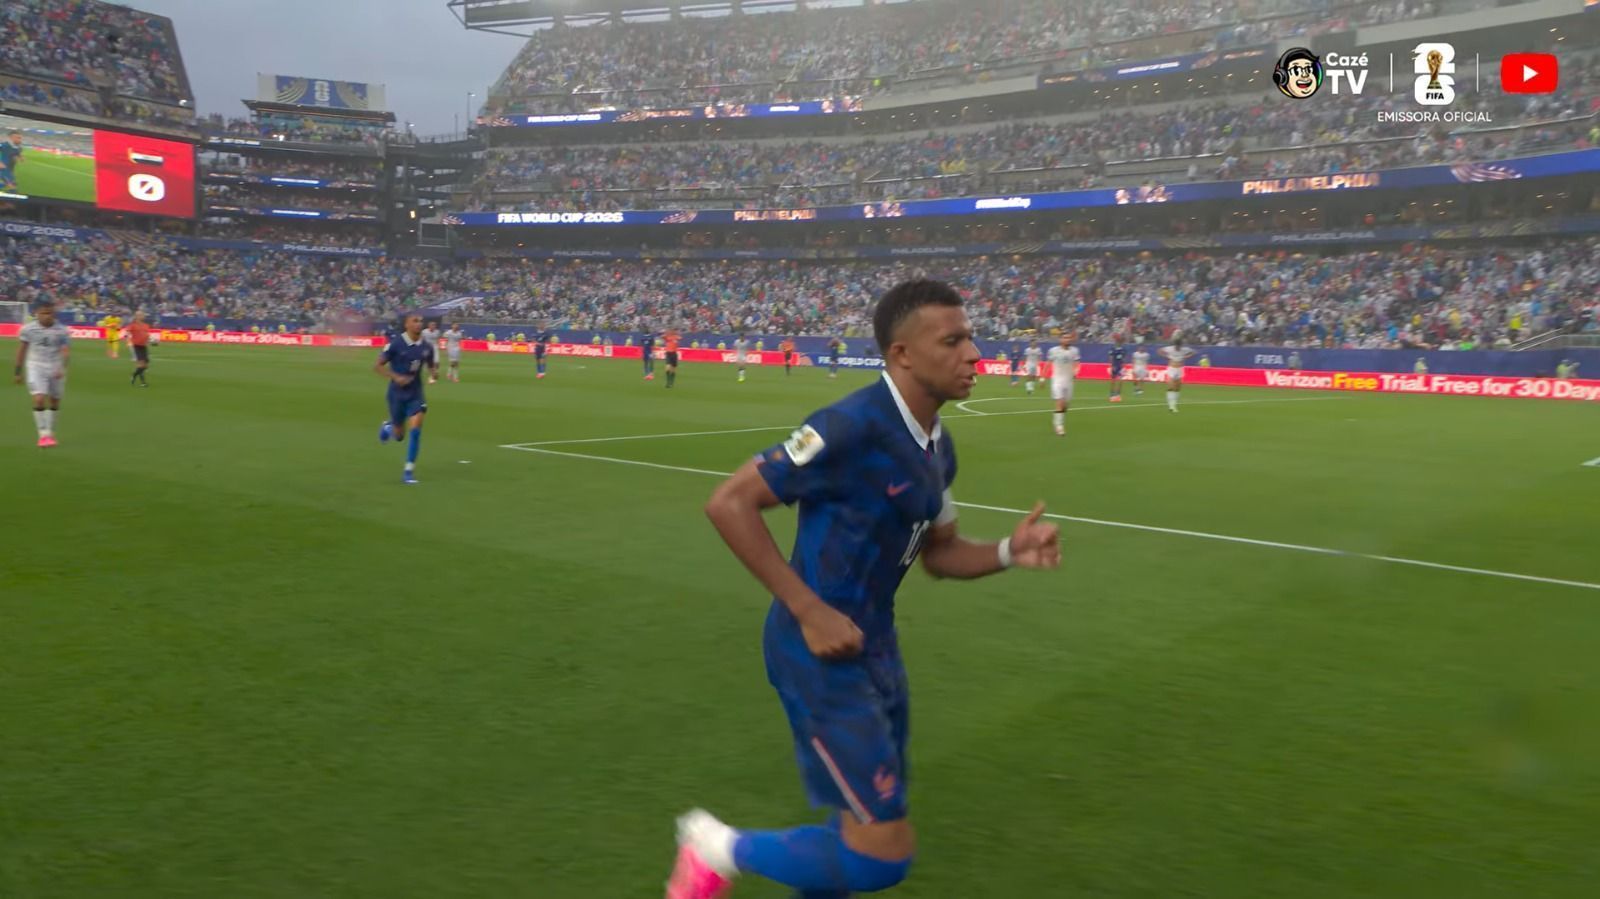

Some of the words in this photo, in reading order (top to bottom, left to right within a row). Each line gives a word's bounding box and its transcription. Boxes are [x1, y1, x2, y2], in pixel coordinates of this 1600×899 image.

[128, 173, 165, 201] 0
[1242, 173, 1381, 194] PHILADELPHIA
[497, 213, 520, 223] FIFA
[520, 213, 560, 223] WORLD
[560, 212, 583, 223] CUP
[583, 212, 624, 223] 2026
[5, 223, 31, 233] CUP
[32, 226, 76, 238] 2026
[283, 243, 371, 254] PHILADELPHIA
[1254, 354, 1284, 365] FIFA
[1265, 371, 1332, 387] Verizon
[1333, 373, 1378, 390] Free
[1379, 374, 1427, 392] Trial.
[1431, 376, 1480, 394] Free
[1481, 378, 1514, 395] for
[1516, 380, 1550, 397] 30
[1553, 380, 1600, 400] Day
